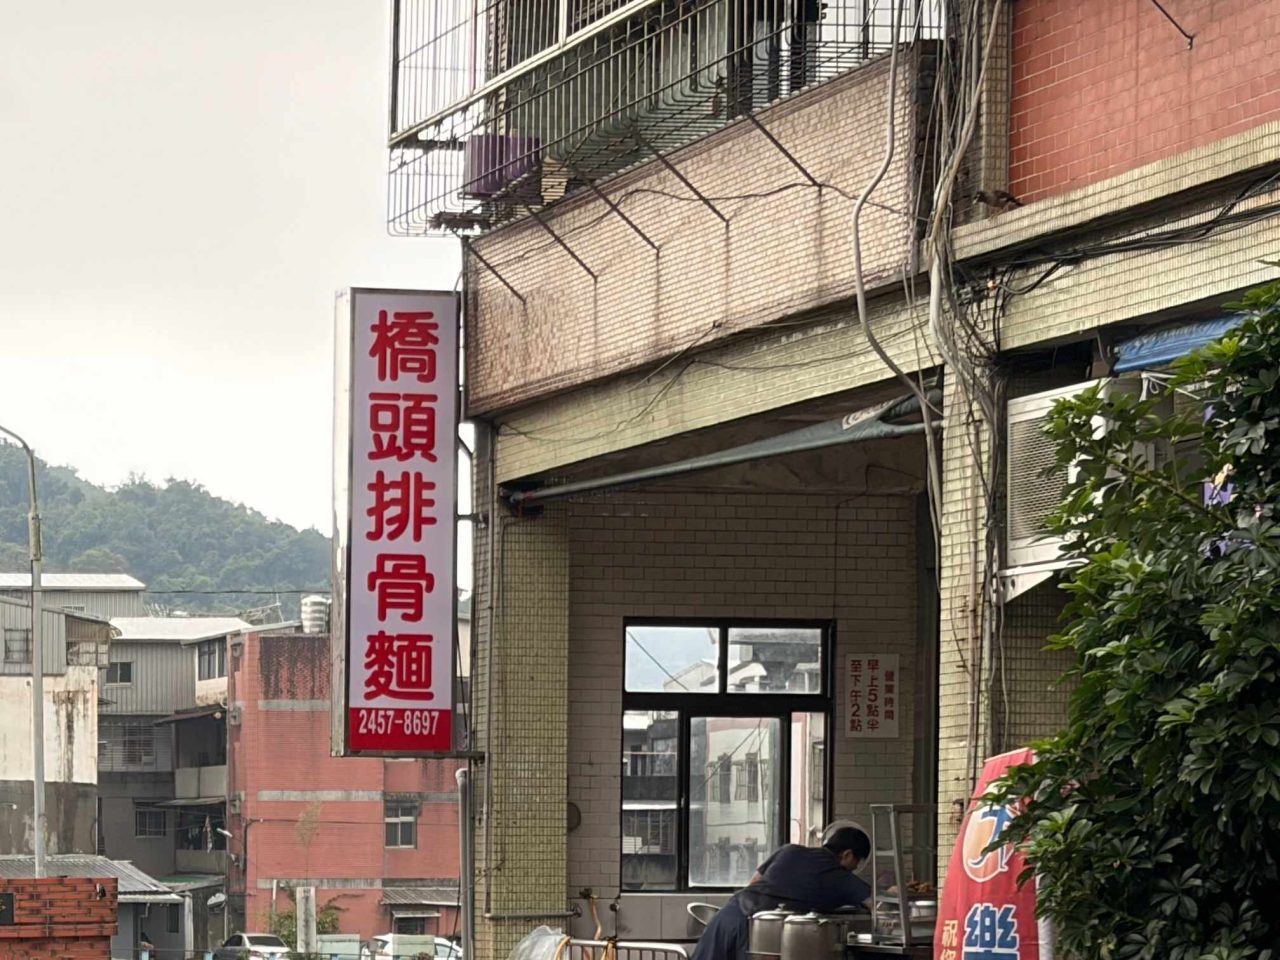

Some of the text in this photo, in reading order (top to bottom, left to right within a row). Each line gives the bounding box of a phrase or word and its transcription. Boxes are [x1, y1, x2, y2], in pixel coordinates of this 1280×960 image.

[363, 309, 440, 702] 橋頭排骨麵
[358, 710, 440, 737] 2457-8697
[849, 659, 863, 732] 至下午2點
